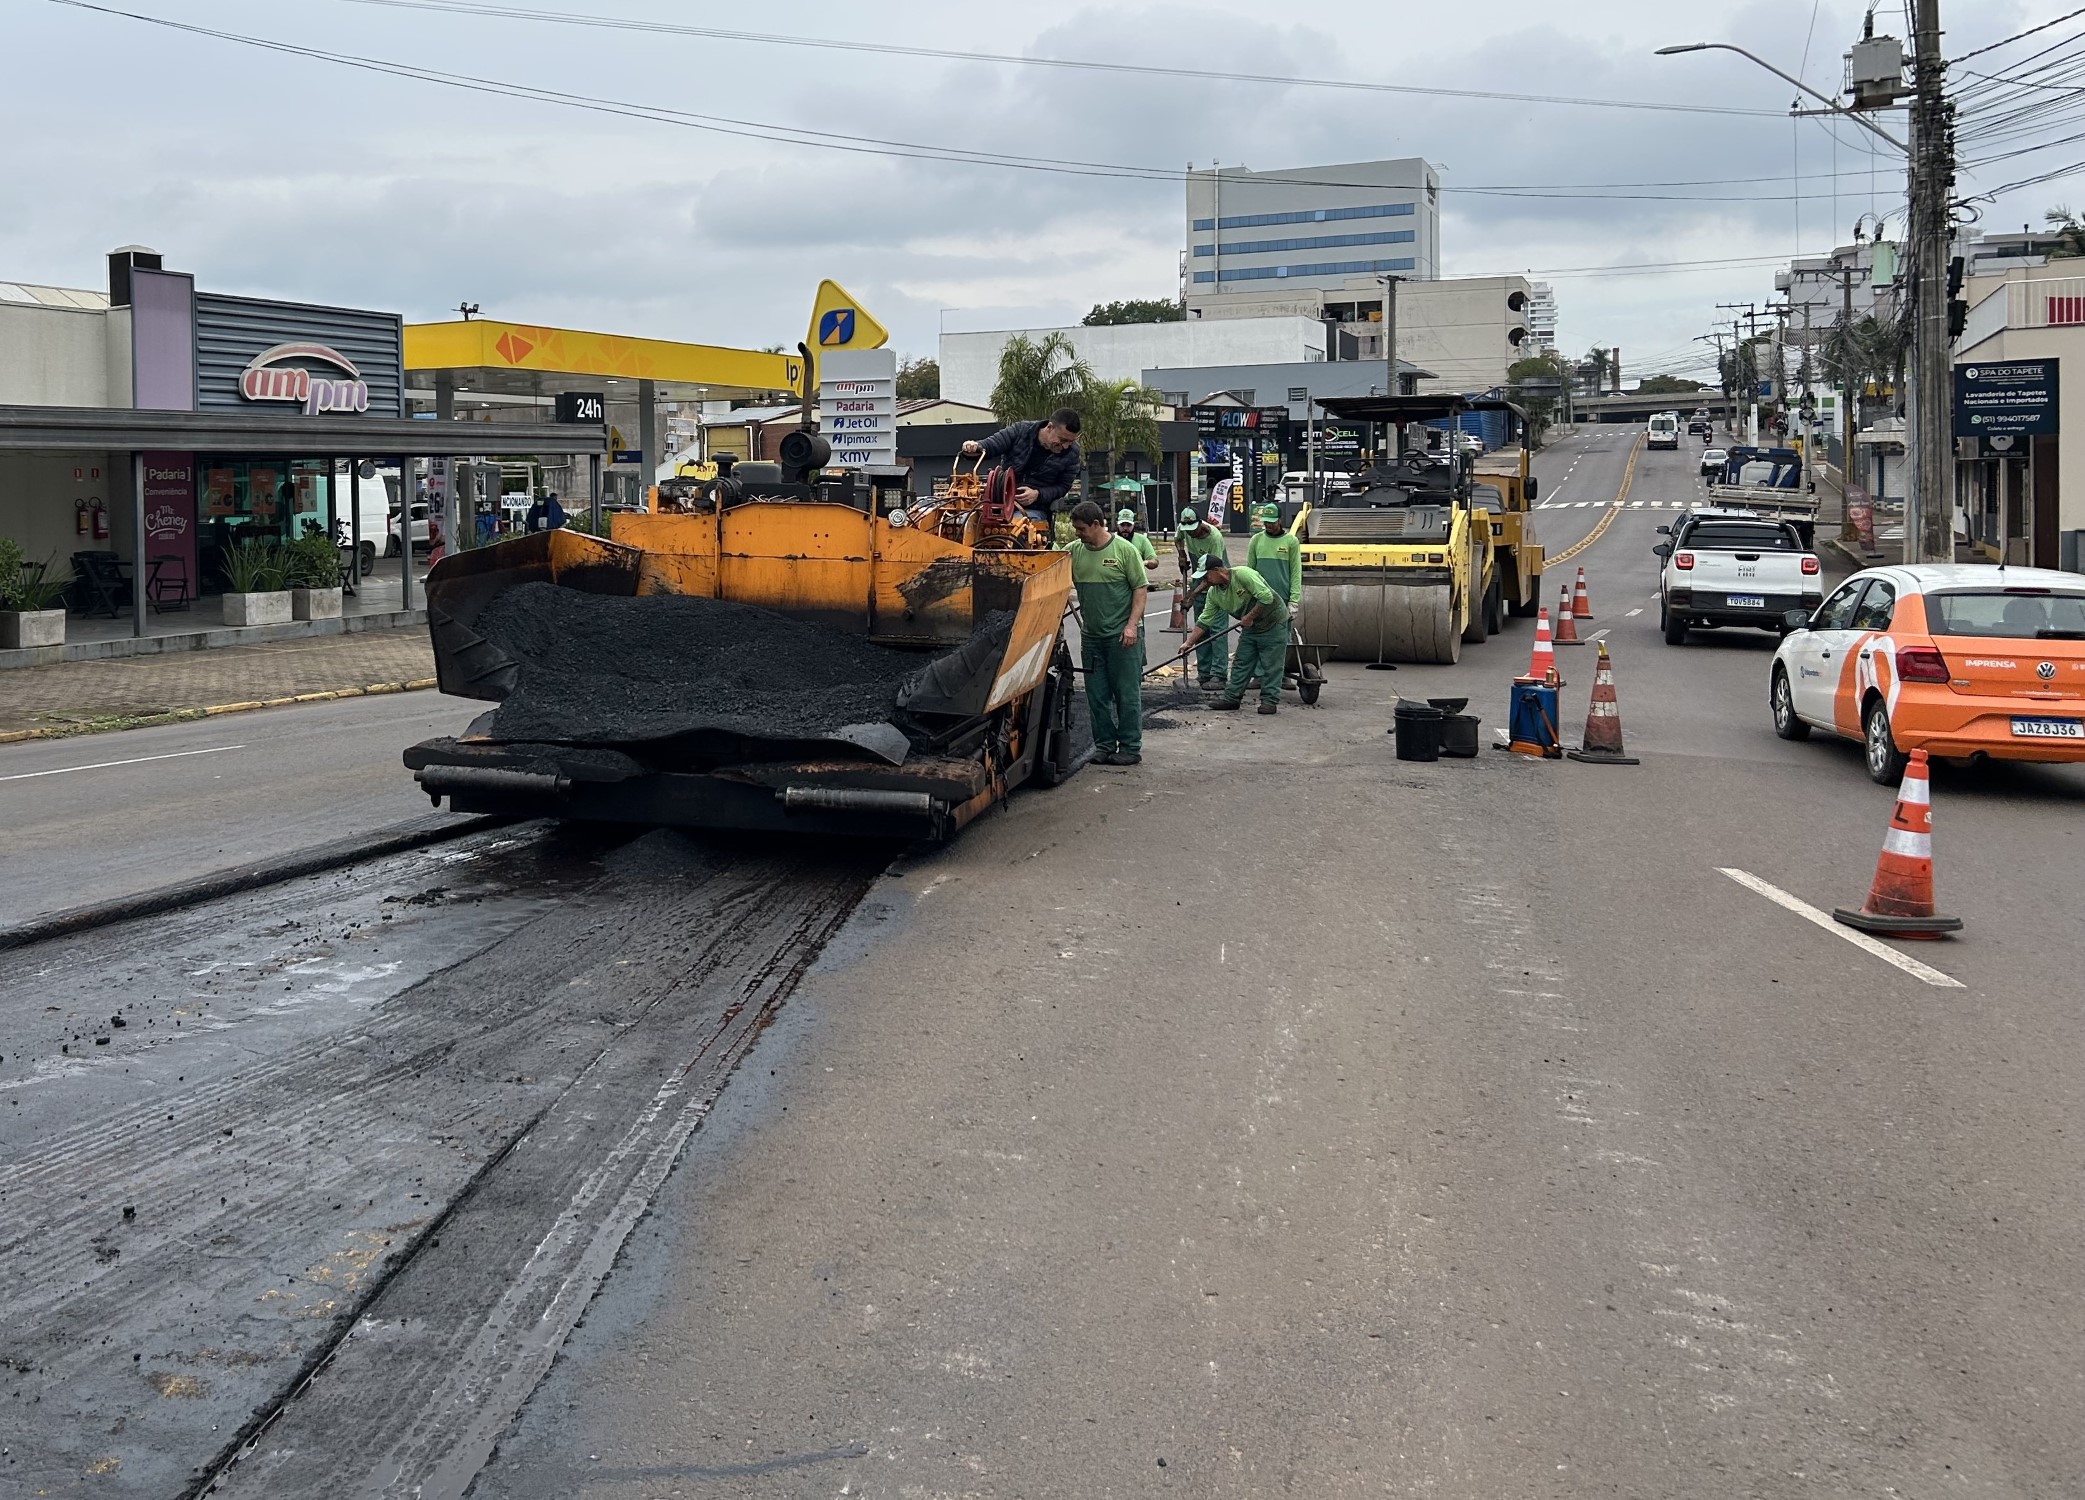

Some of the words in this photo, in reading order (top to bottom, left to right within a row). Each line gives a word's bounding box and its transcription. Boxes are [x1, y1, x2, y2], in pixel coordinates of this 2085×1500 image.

[2011, 367, 2044, 375] TAPETE
[835, 382, 875, 396] ampm
[576, 398, 602, 418] 24h
[836, 401, 875, 411] Padaria
[843, 435, 878, 446] Ipimax
[840, 451, 871, 463] KMV
[1232, 452, 1244, 513] SUBWAY
[1965, 659, 2017, 669] IMPRENSA
[2018, 722, 2077, 736] JAZ8J36
